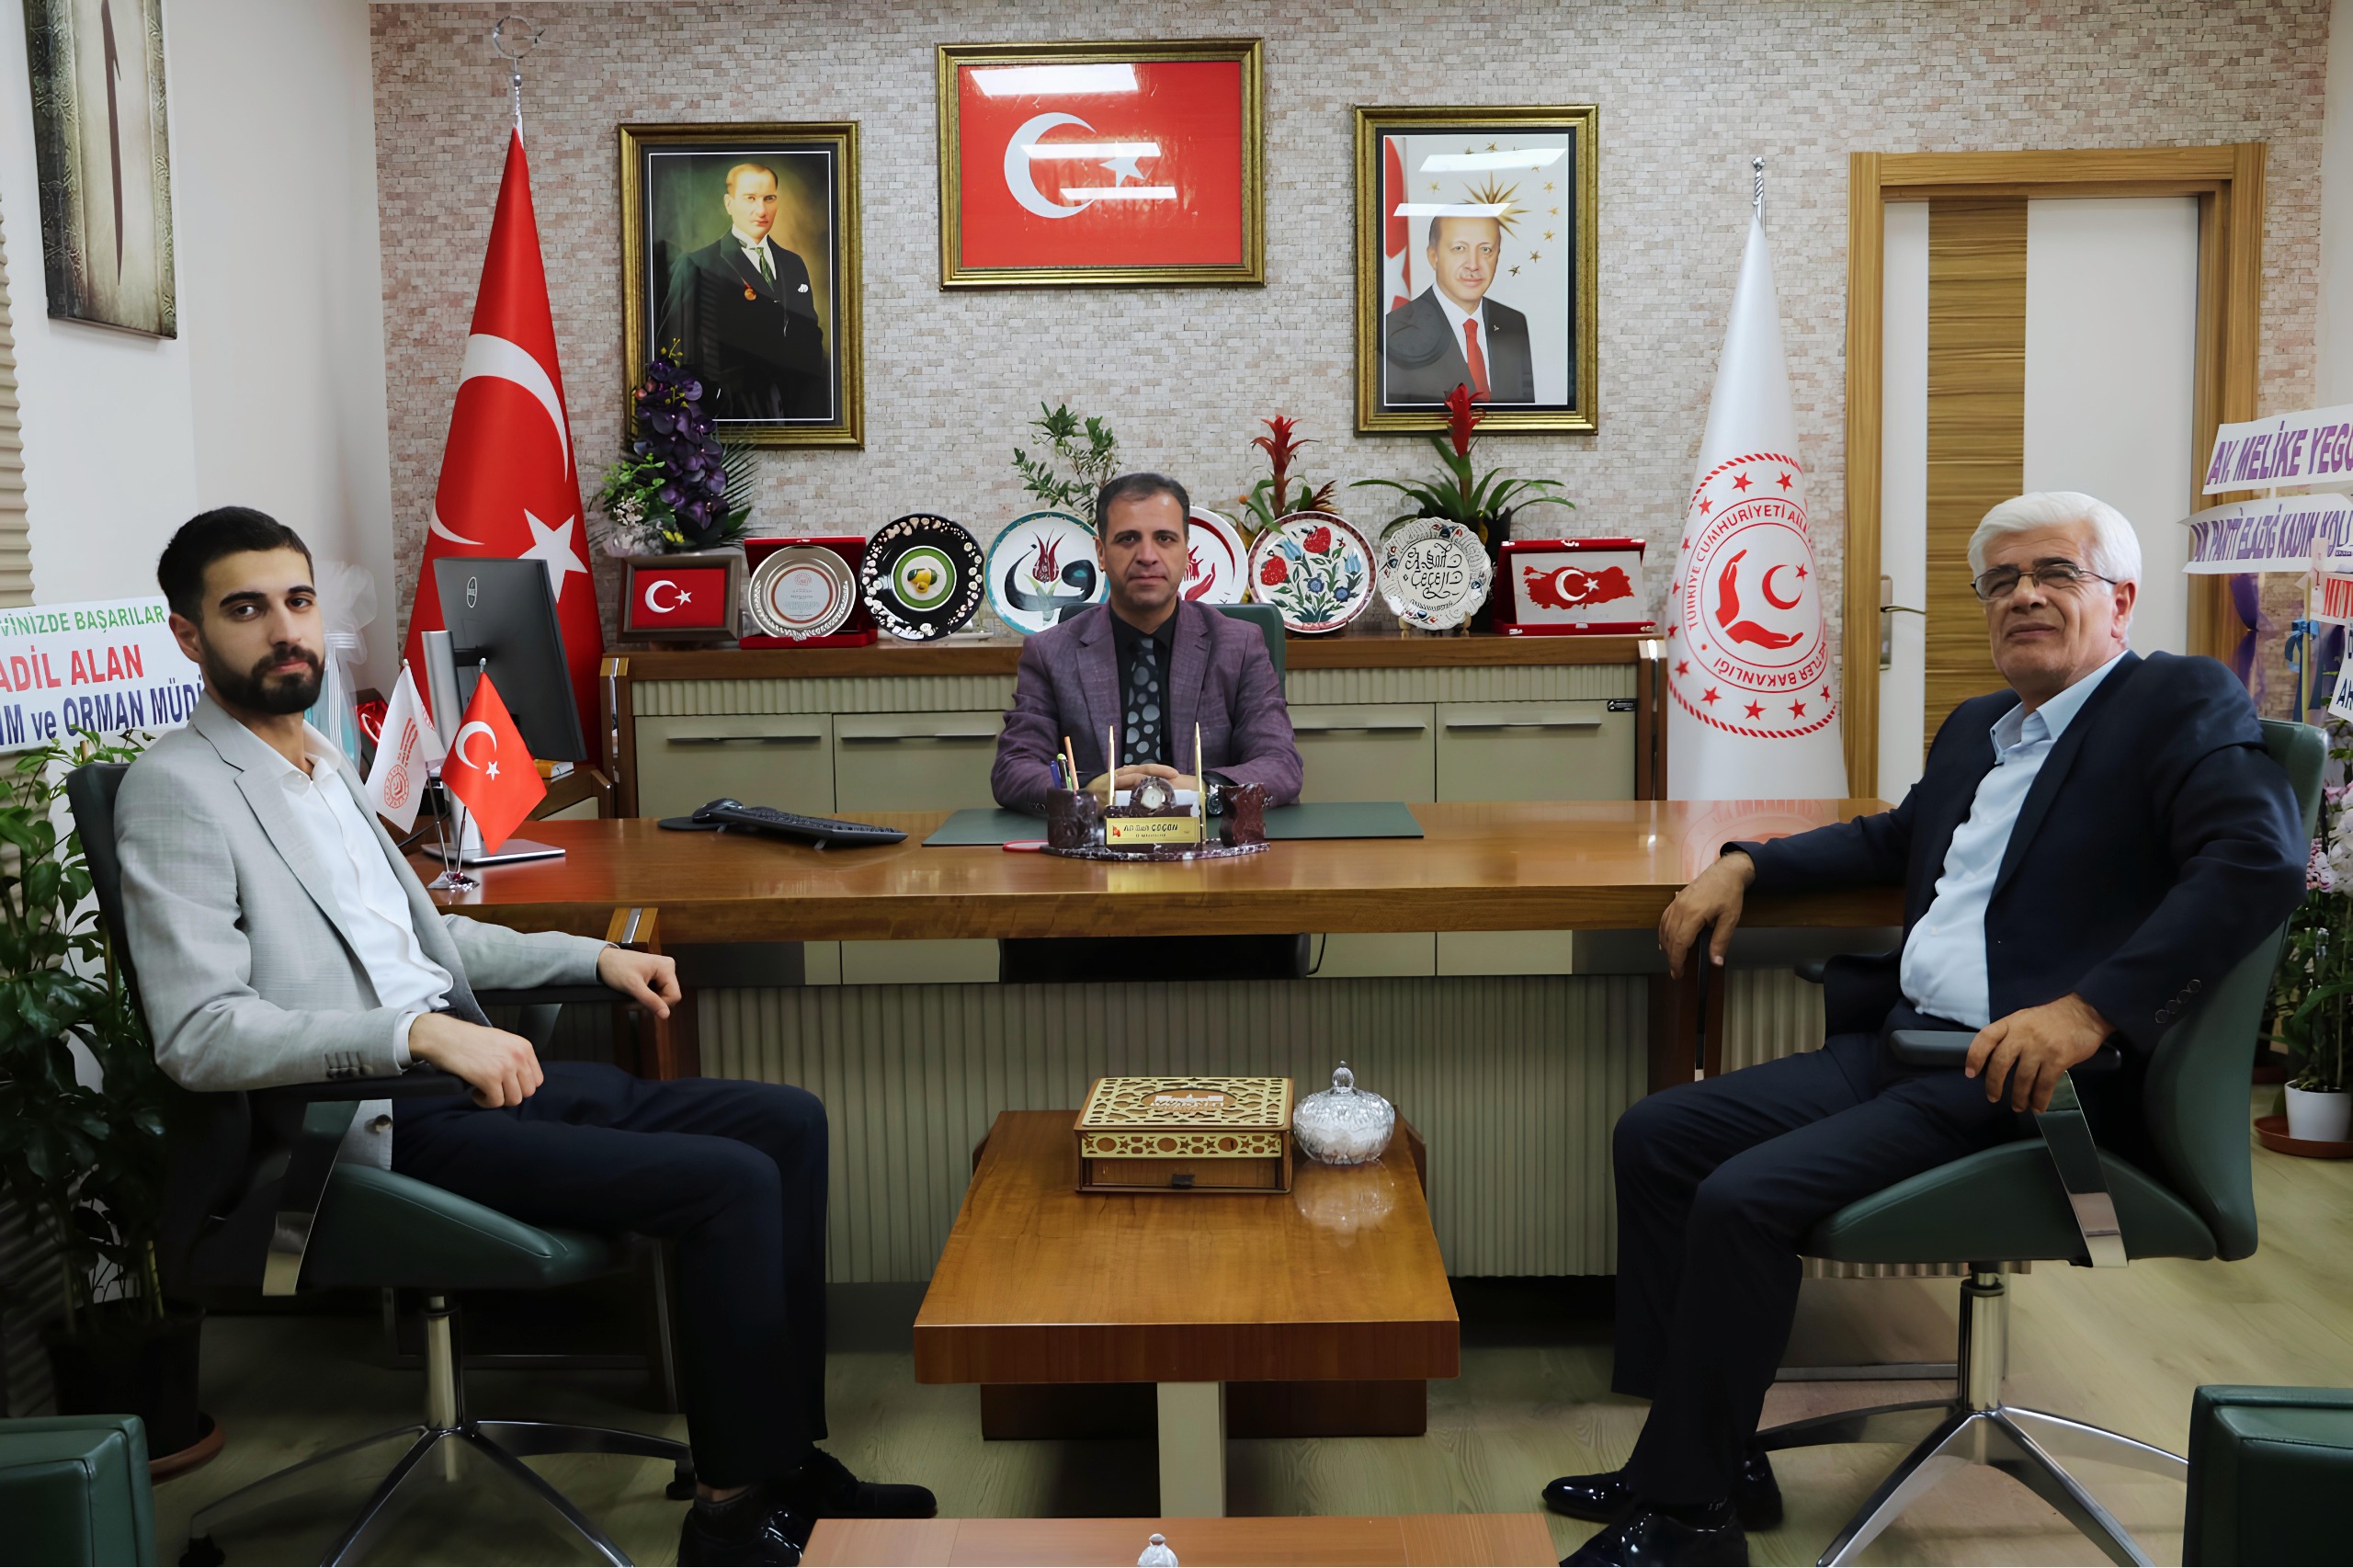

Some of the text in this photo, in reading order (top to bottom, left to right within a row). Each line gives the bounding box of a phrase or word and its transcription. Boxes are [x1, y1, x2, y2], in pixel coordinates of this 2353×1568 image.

[2233, 420, 2308, 482] MELİKE
[0, 605, 166, 636] VİNİZDE BAŞARILAR
[71, 643, 144, 686] ALAN
[1713, 657, 1797, 687] BAKANLIĞI
[30, 710, 57, 741] ve
[63, 689, 144, 736] ORMAN
